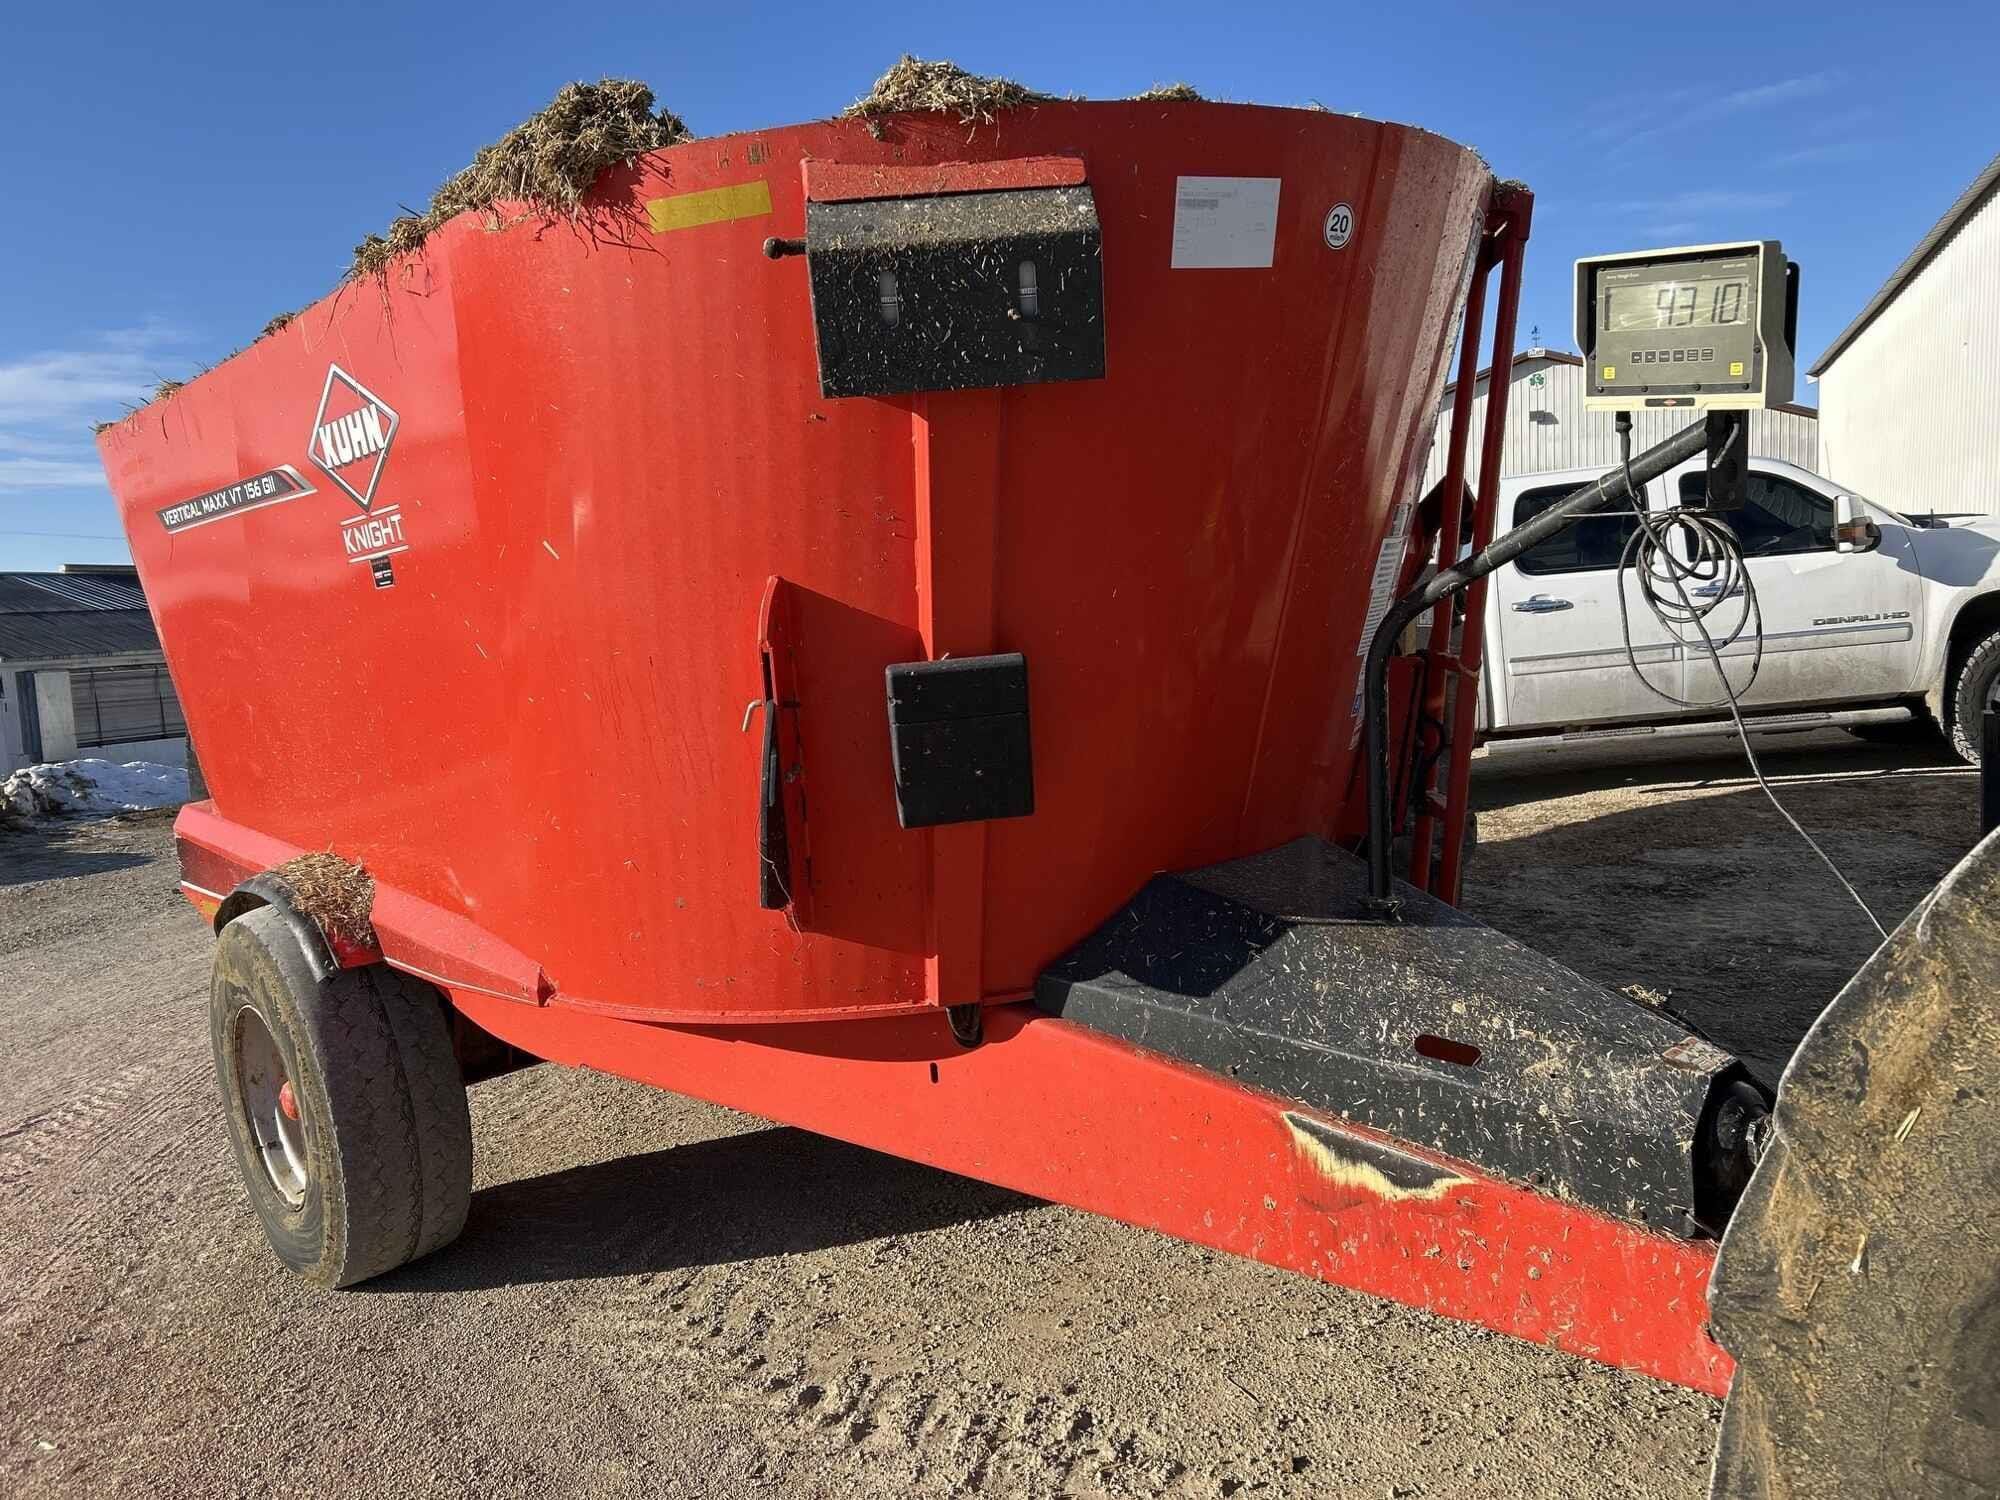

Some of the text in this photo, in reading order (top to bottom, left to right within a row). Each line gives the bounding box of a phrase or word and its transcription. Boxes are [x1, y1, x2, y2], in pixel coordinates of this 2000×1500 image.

[1330, 213, 1349, 233] 20
[1657, 283, 1742, 326] 4310
[319, 403, 386, 470] KUHN
[162, 474, 275, 526] VERTICAL MAXX VT 156 GII
[342, 513, 404, 555] KNIGHT
[1812, 611, 1911, 626] DENALI HD
